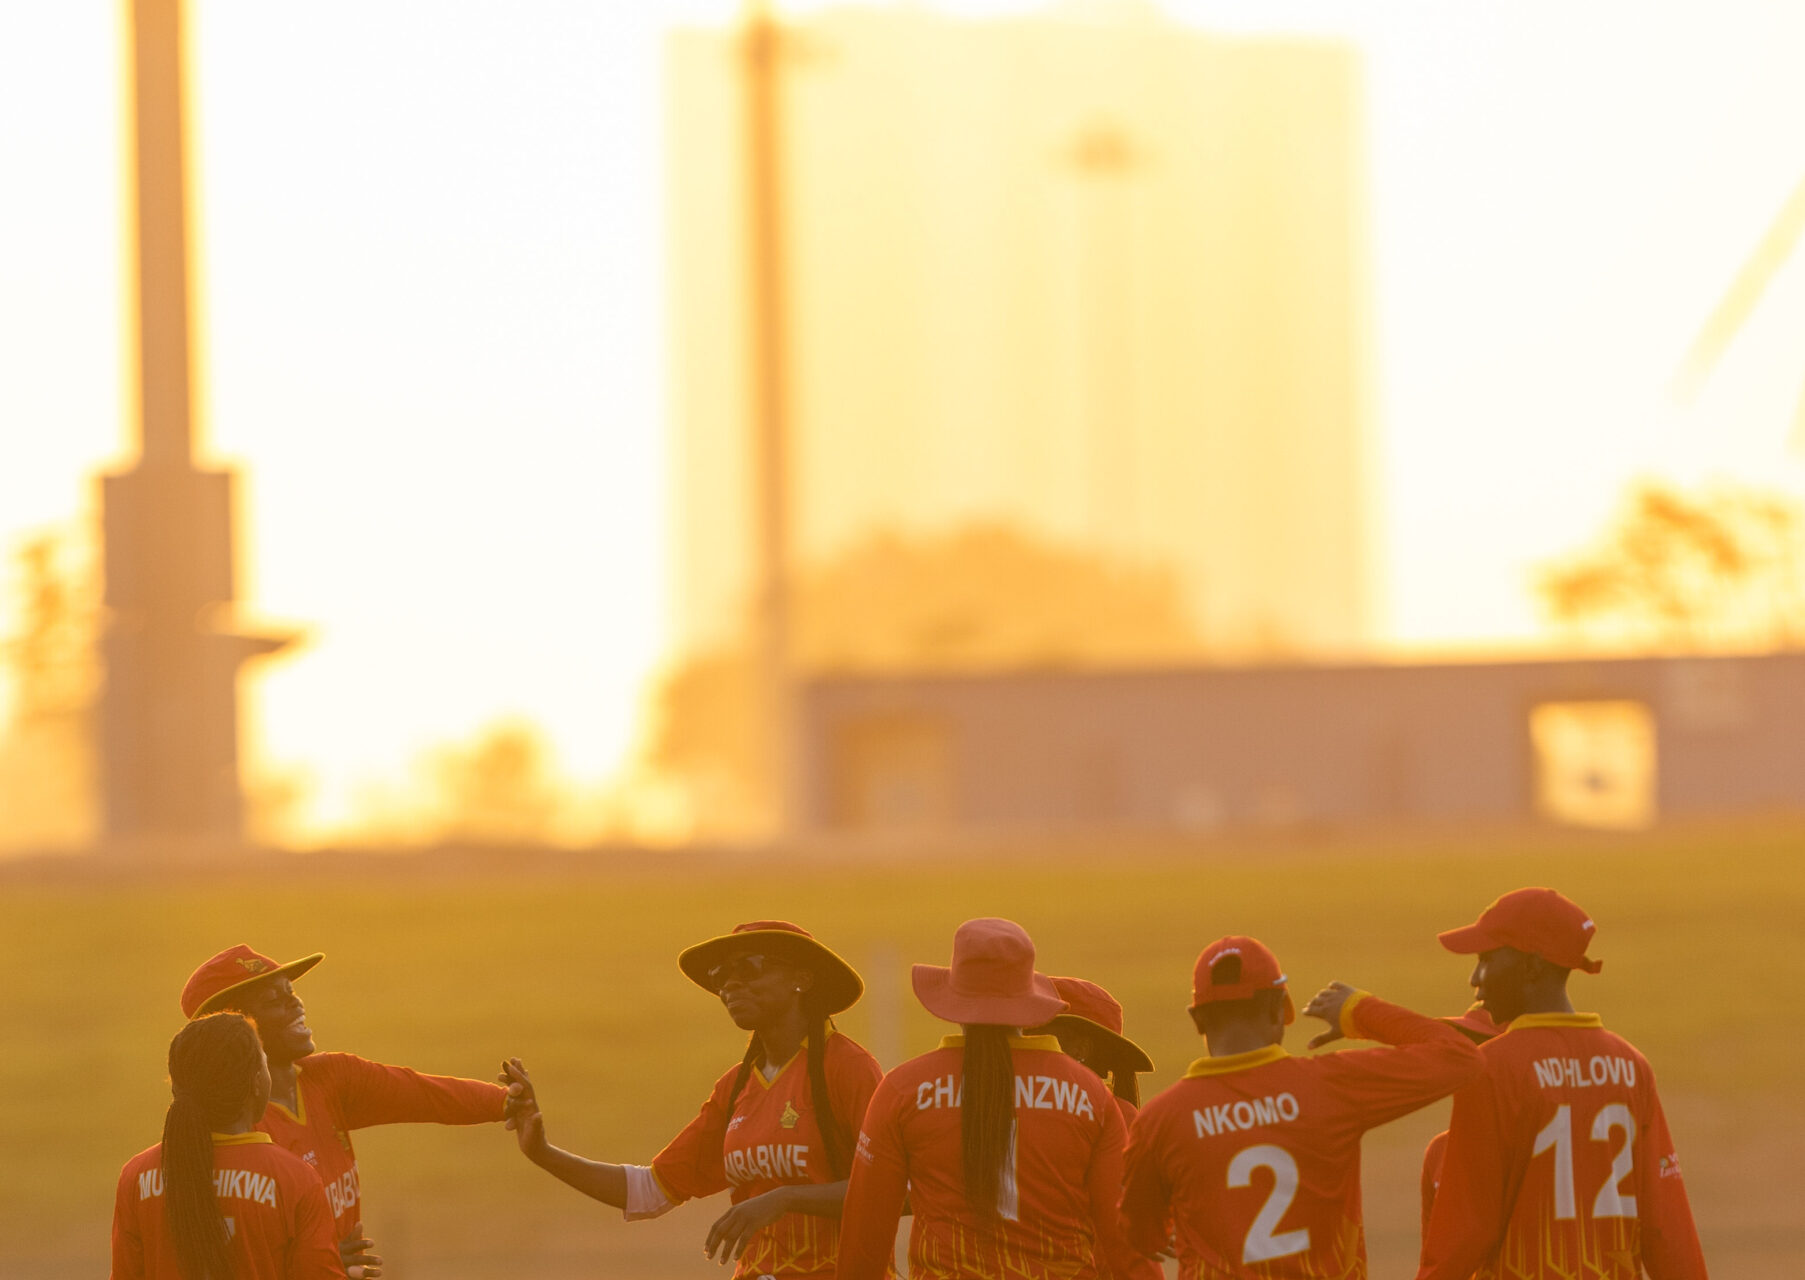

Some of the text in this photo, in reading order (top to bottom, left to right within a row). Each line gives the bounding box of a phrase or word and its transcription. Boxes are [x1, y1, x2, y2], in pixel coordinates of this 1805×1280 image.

[1533, 1056, 1636, 1088] NDHLOVU
[917, 1074, 1094, 1121] CHNZWA
[1193, 1092, 1299, 1138] NKOMO
[1532, 1103, 1638, 1220] 12
[139, 1168, 277, 1208] MUHIKWA
[1227, 1144, 1310, 1264] 2
